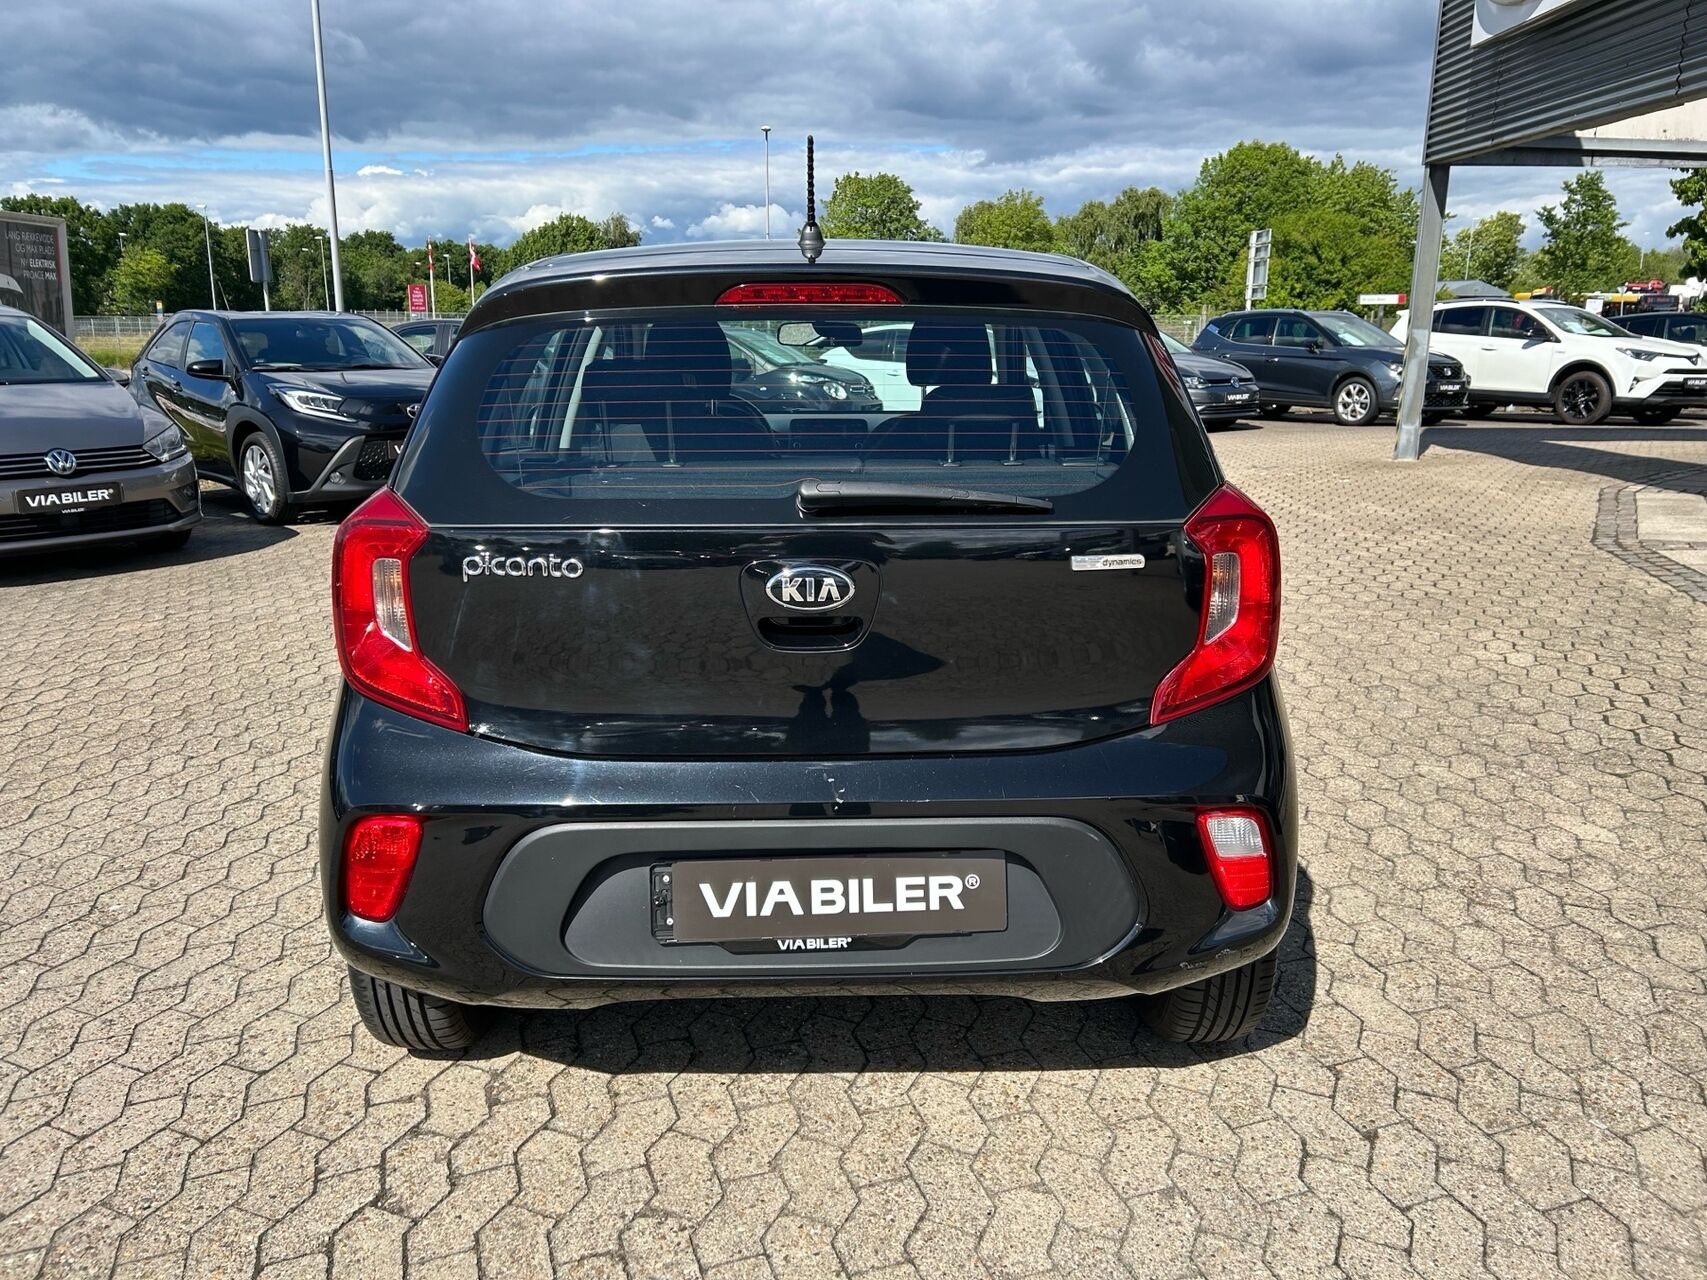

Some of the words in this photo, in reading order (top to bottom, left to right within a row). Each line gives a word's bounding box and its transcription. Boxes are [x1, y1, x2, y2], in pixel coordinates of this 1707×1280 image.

[29, 258, 56, 270] ELEKTRISK
[45, 271, 57, 281] MAX
[462, 552, 583, 582] picanto
[1102, 558, 1142, 568] dynamics
[781, 577, 841, 602] KIA
